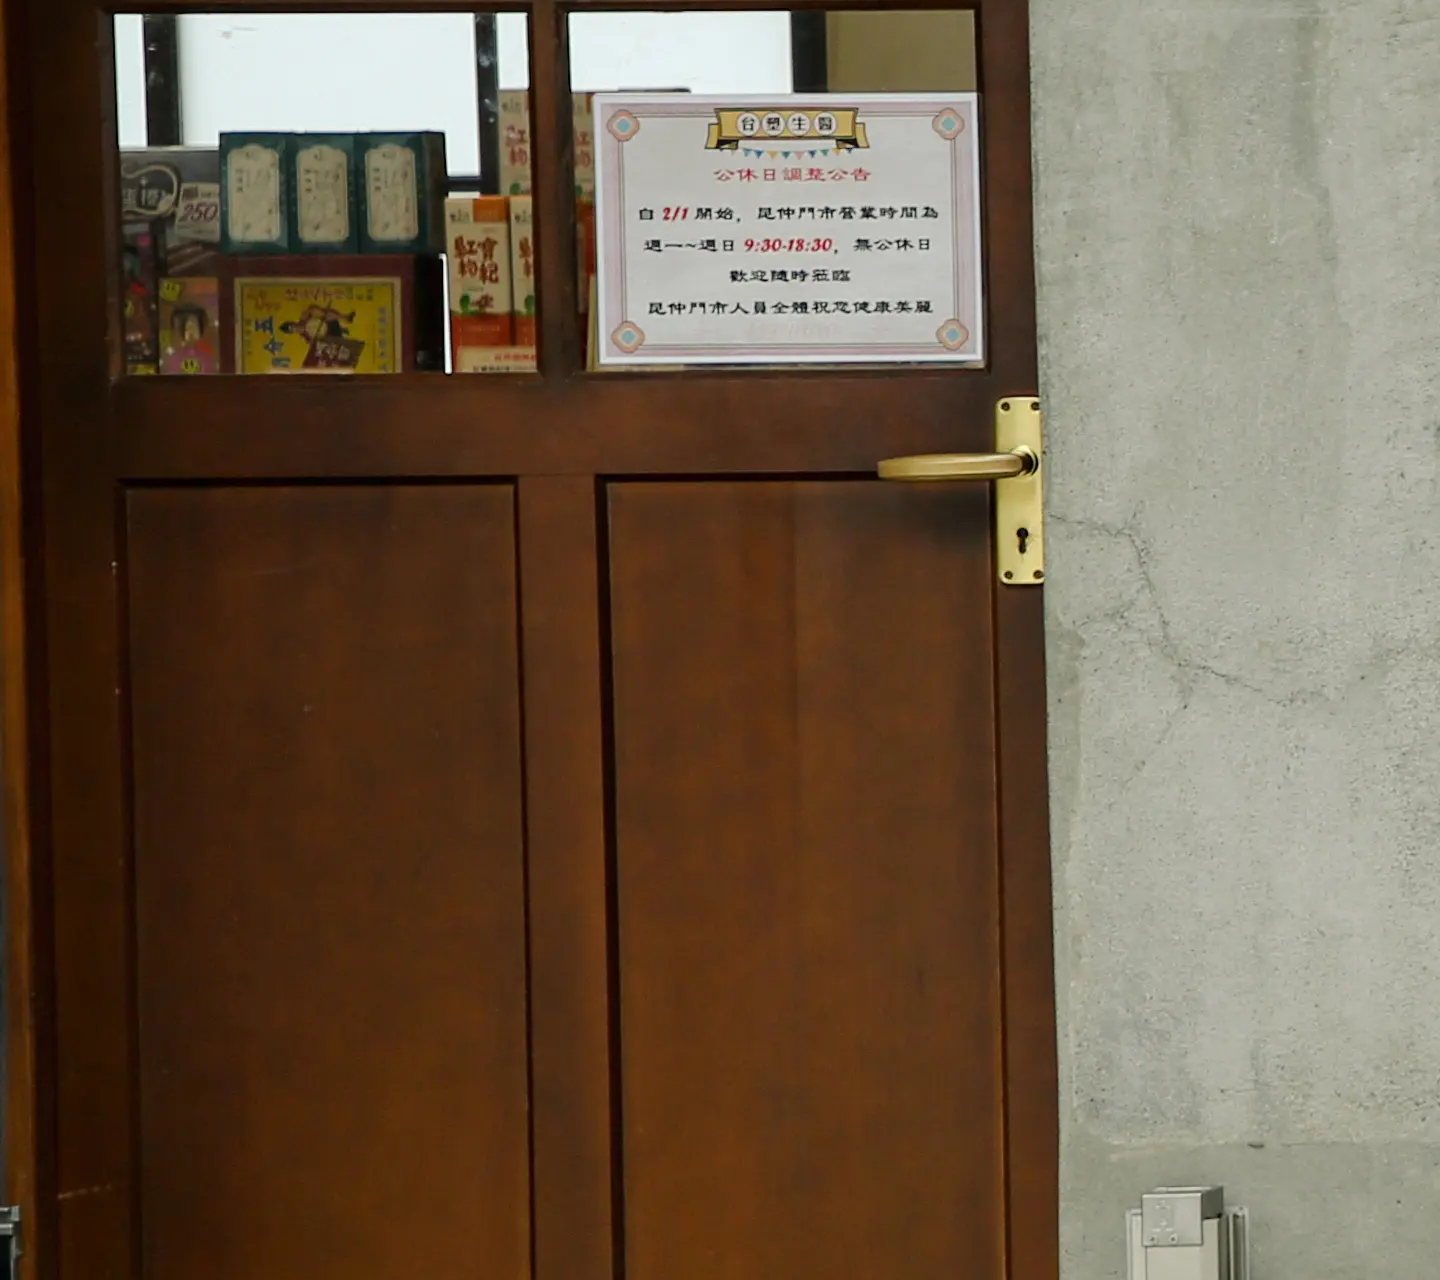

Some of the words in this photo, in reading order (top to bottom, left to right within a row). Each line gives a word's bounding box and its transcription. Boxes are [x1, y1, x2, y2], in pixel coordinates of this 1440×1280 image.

[741, 116, 834, 132] 台塑生醫
[714, 167, 872, 183] 公休日調整公告
[639, 208, 654, 220] 自
[662, 206, 689, 220] 2/1
[730, 269, 851, 283] 歡迎隨時蒞臨
